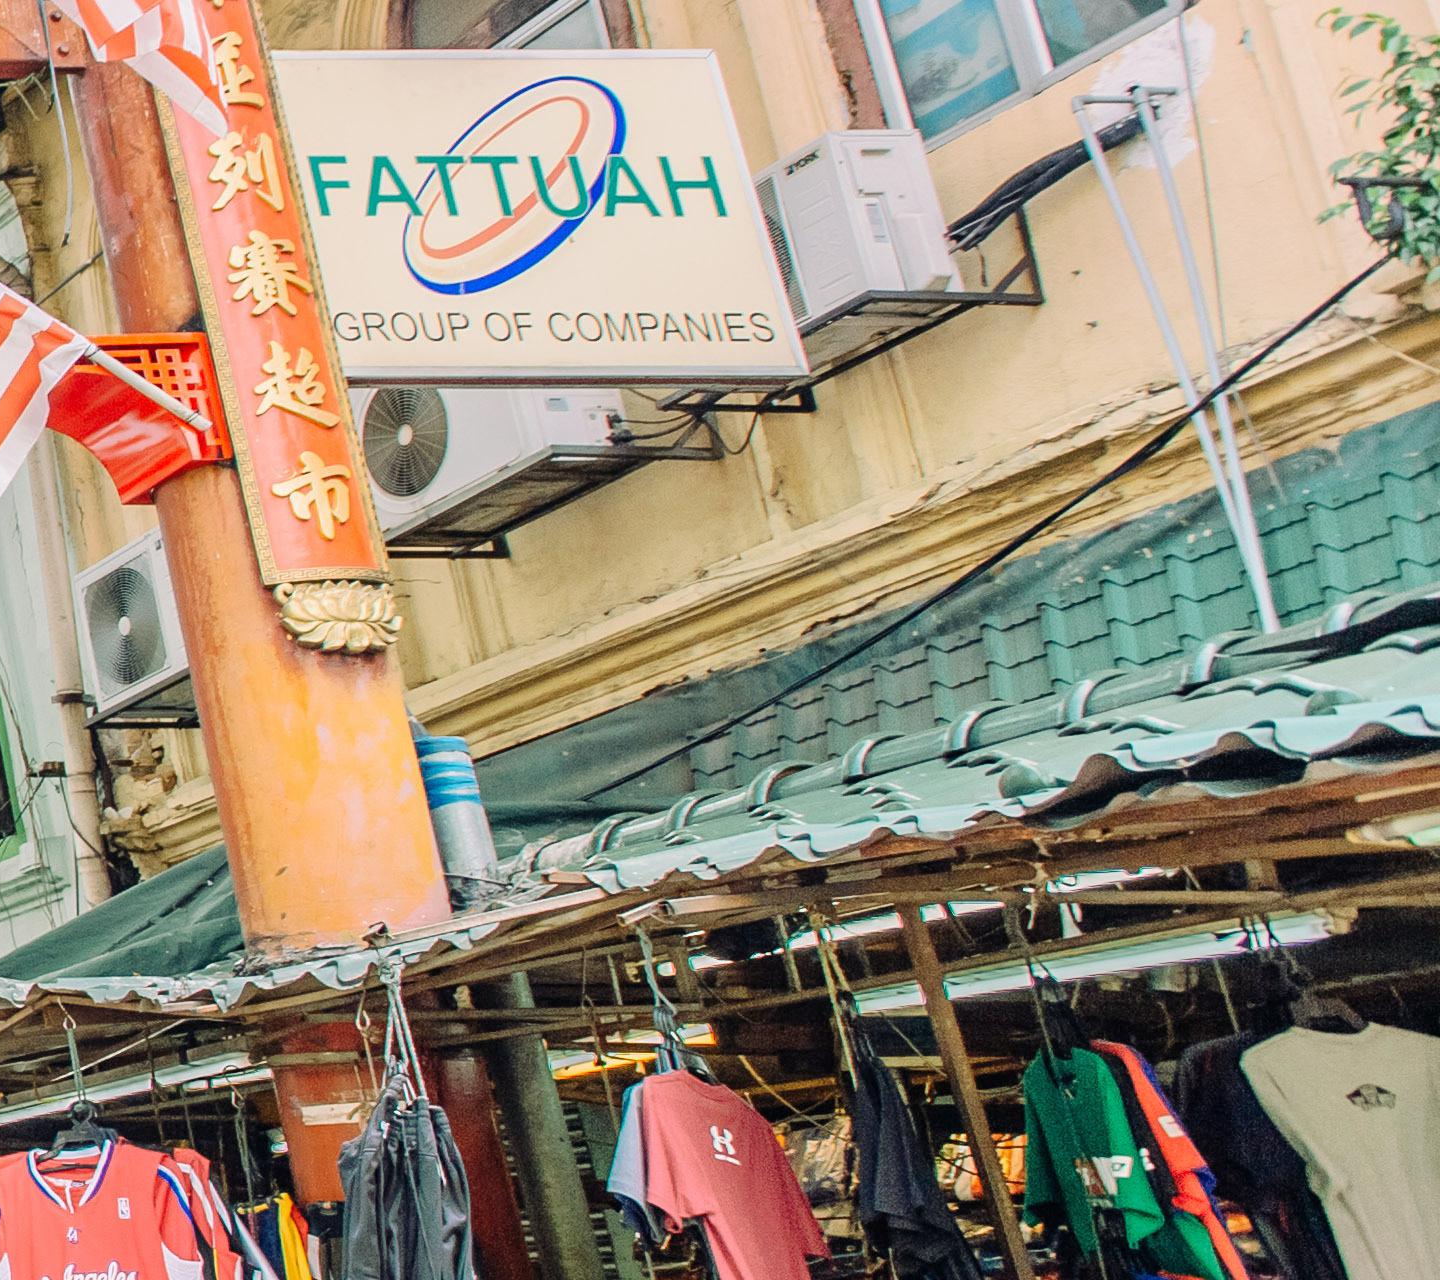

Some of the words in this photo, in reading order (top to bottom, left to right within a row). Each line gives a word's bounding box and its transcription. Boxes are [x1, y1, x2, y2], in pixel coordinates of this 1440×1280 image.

[306, 153, 729, 220] FATTUAH
[334, 311, 469, 345] GROUP
[483, 311, 535, 345] OF
[547, 311, 776, 345] COMPANIES
